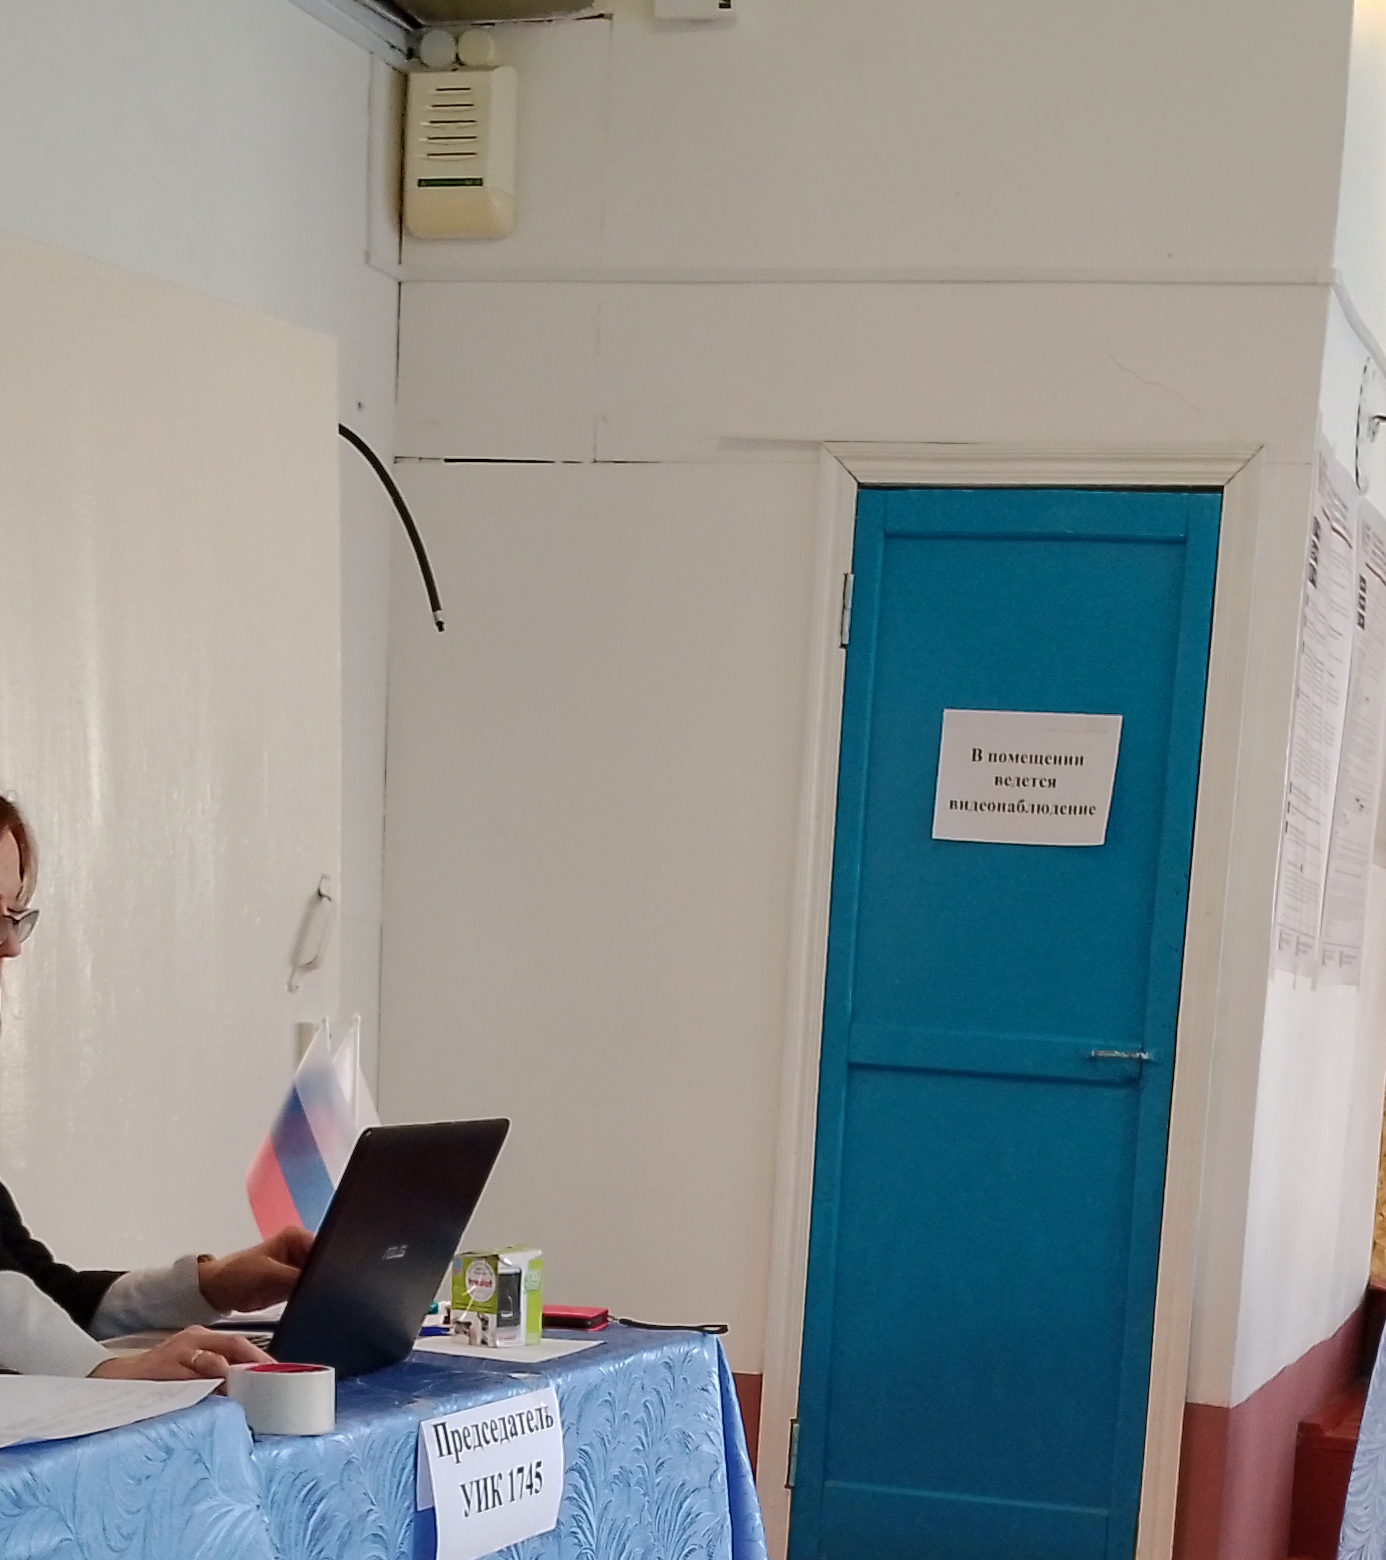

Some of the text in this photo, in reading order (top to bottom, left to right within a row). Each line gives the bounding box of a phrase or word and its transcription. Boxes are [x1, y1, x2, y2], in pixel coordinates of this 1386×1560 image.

[971, 748, 1085, 767] В помещении
[994, 775, 1057, 789] ведется
[949, 799, 1097, 816] видеонаблюдение
[433, 1405, 555, 1465] Председатель
[460, 1461, 544, 1518] УИК 1745
